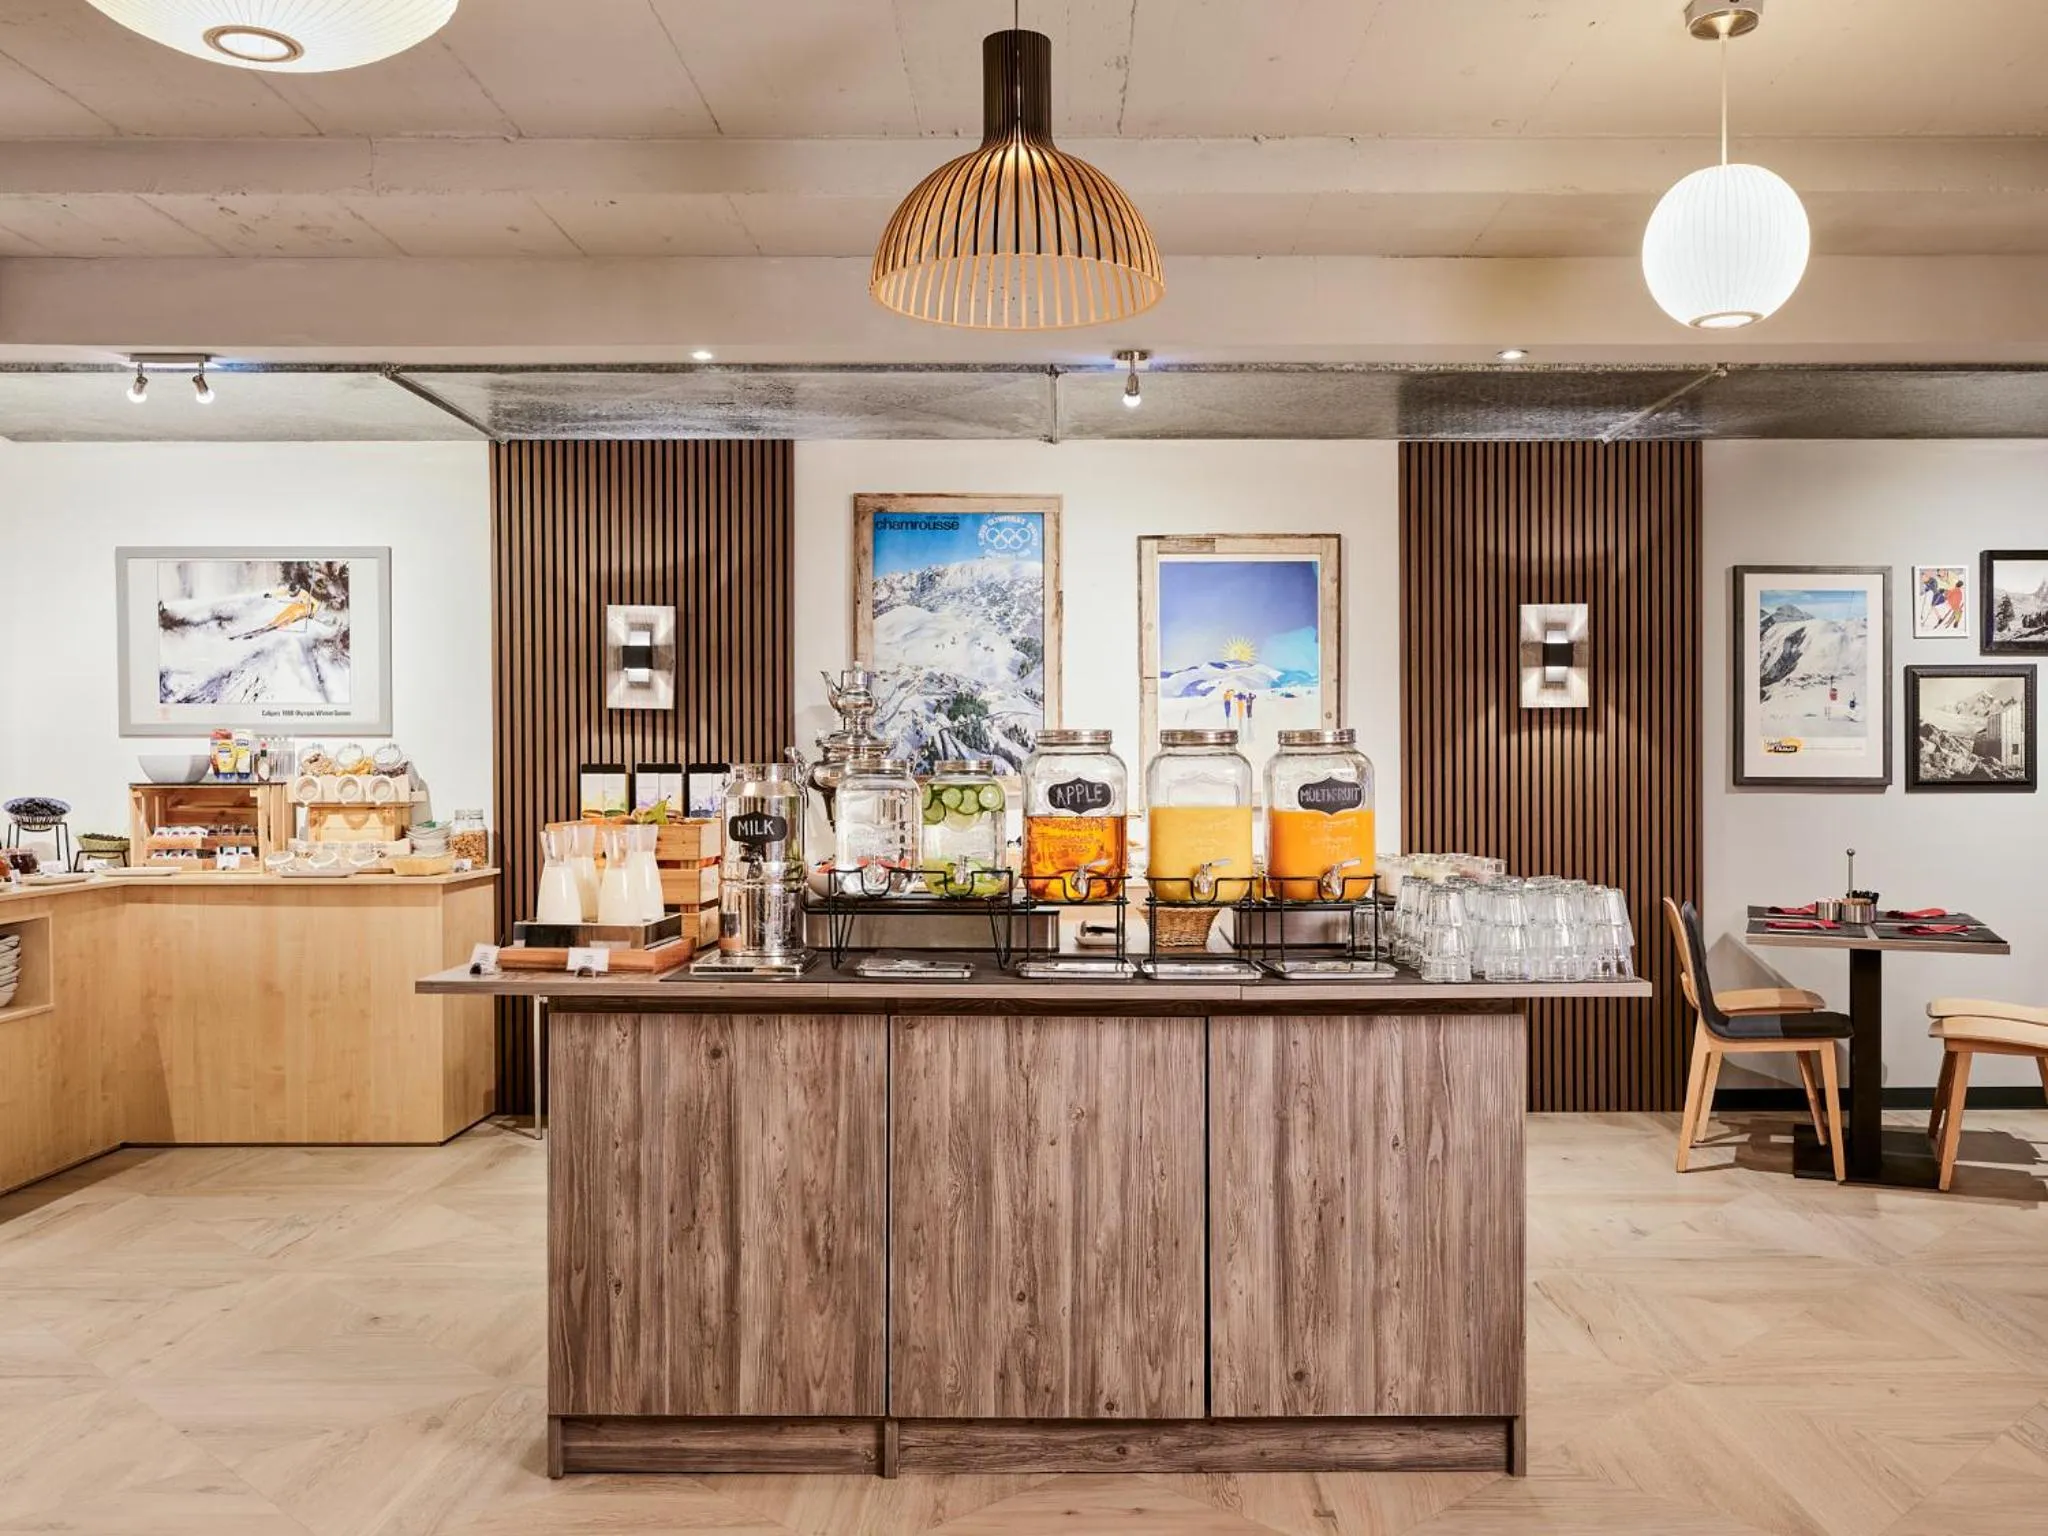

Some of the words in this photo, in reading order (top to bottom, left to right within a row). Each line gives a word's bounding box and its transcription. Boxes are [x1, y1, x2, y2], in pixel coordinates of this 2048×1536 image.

[875, 517, 960, 531] chamrousse
[1056, 783, 1103, 806] APPLE
[737, 820, 774, 836] MILK
